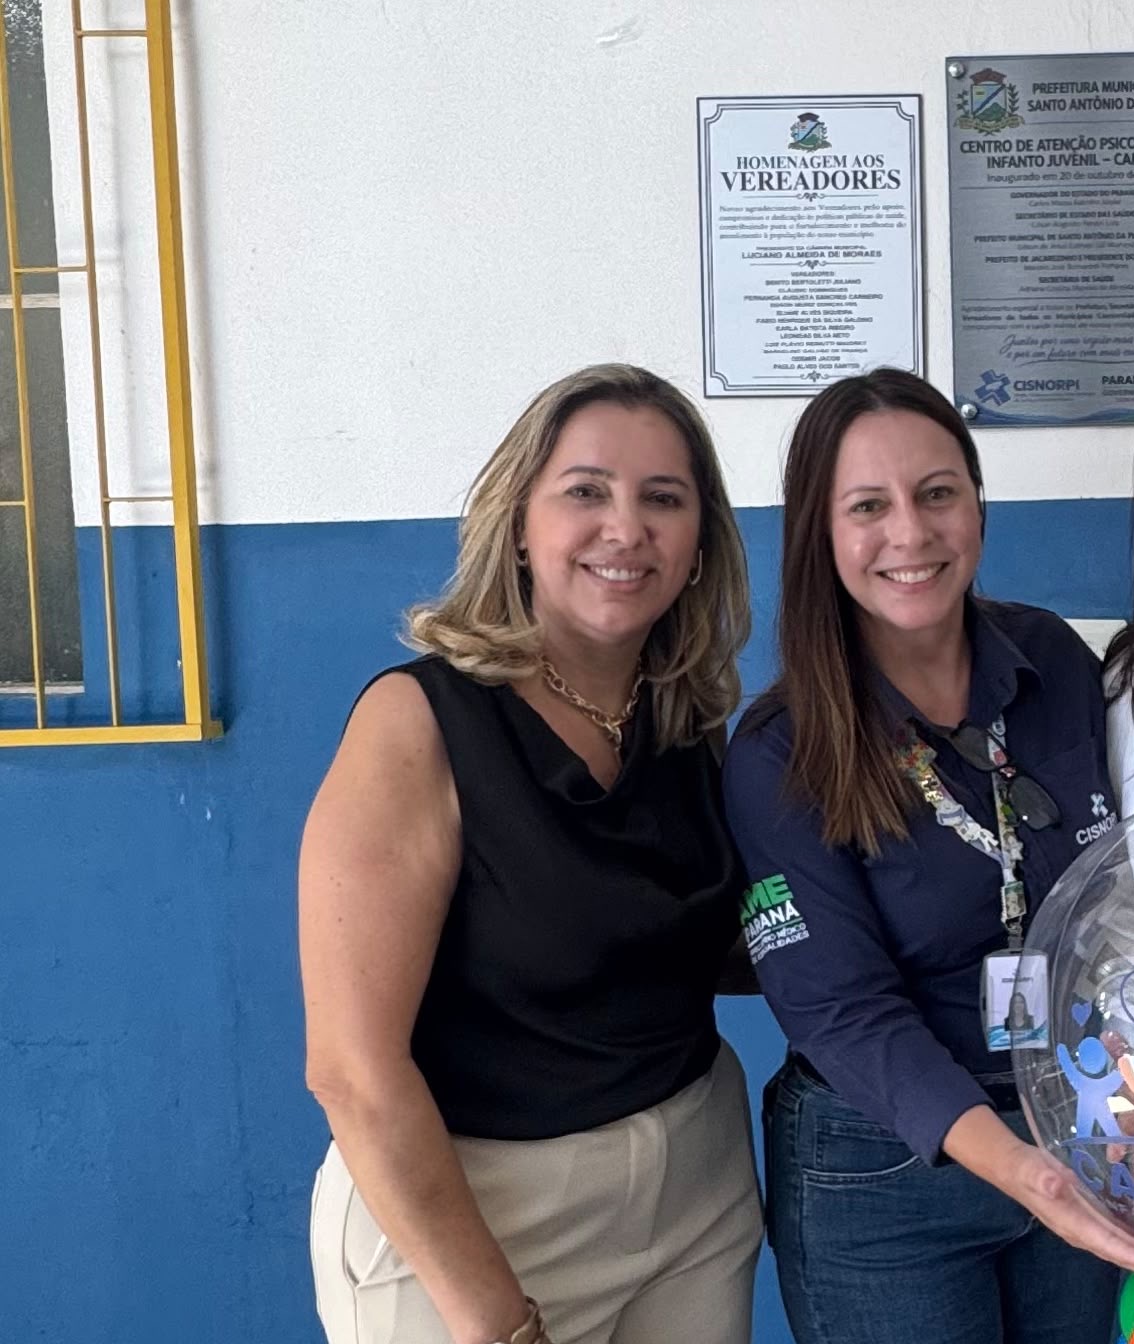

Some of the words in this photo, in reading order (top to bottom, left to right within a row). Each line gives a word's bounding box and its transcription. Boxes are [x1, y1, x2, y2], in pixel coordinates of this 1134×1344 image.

[1032, 82, 1099, 94] PREFEITURA
[1027, 99, 1067, 112] SANTO
[1069, 95, 1124, 110] ANTÔNIO
[960, 140, 1013, 153] CENTRO
[1016, 139, 1034, 152] DE
[1037, 135, 1097, 154] ATENÇÃO
[736, 155, 847, 170] HOMENAGEM
[851, 154, 884, 168] AOS
[986, 155, 1045, 169] INFANTO
[1047, 154, 1100, 167] JUVENIL
[720, 169, 901, 192] VEREADORES
[987, 173, 1040, 184] Inaugurado
[785, 251, 825, 259] ALMEIDA
[843, 250, 882, 258] MORAES
[1013, 379, 1080, 392] CISNORPI
